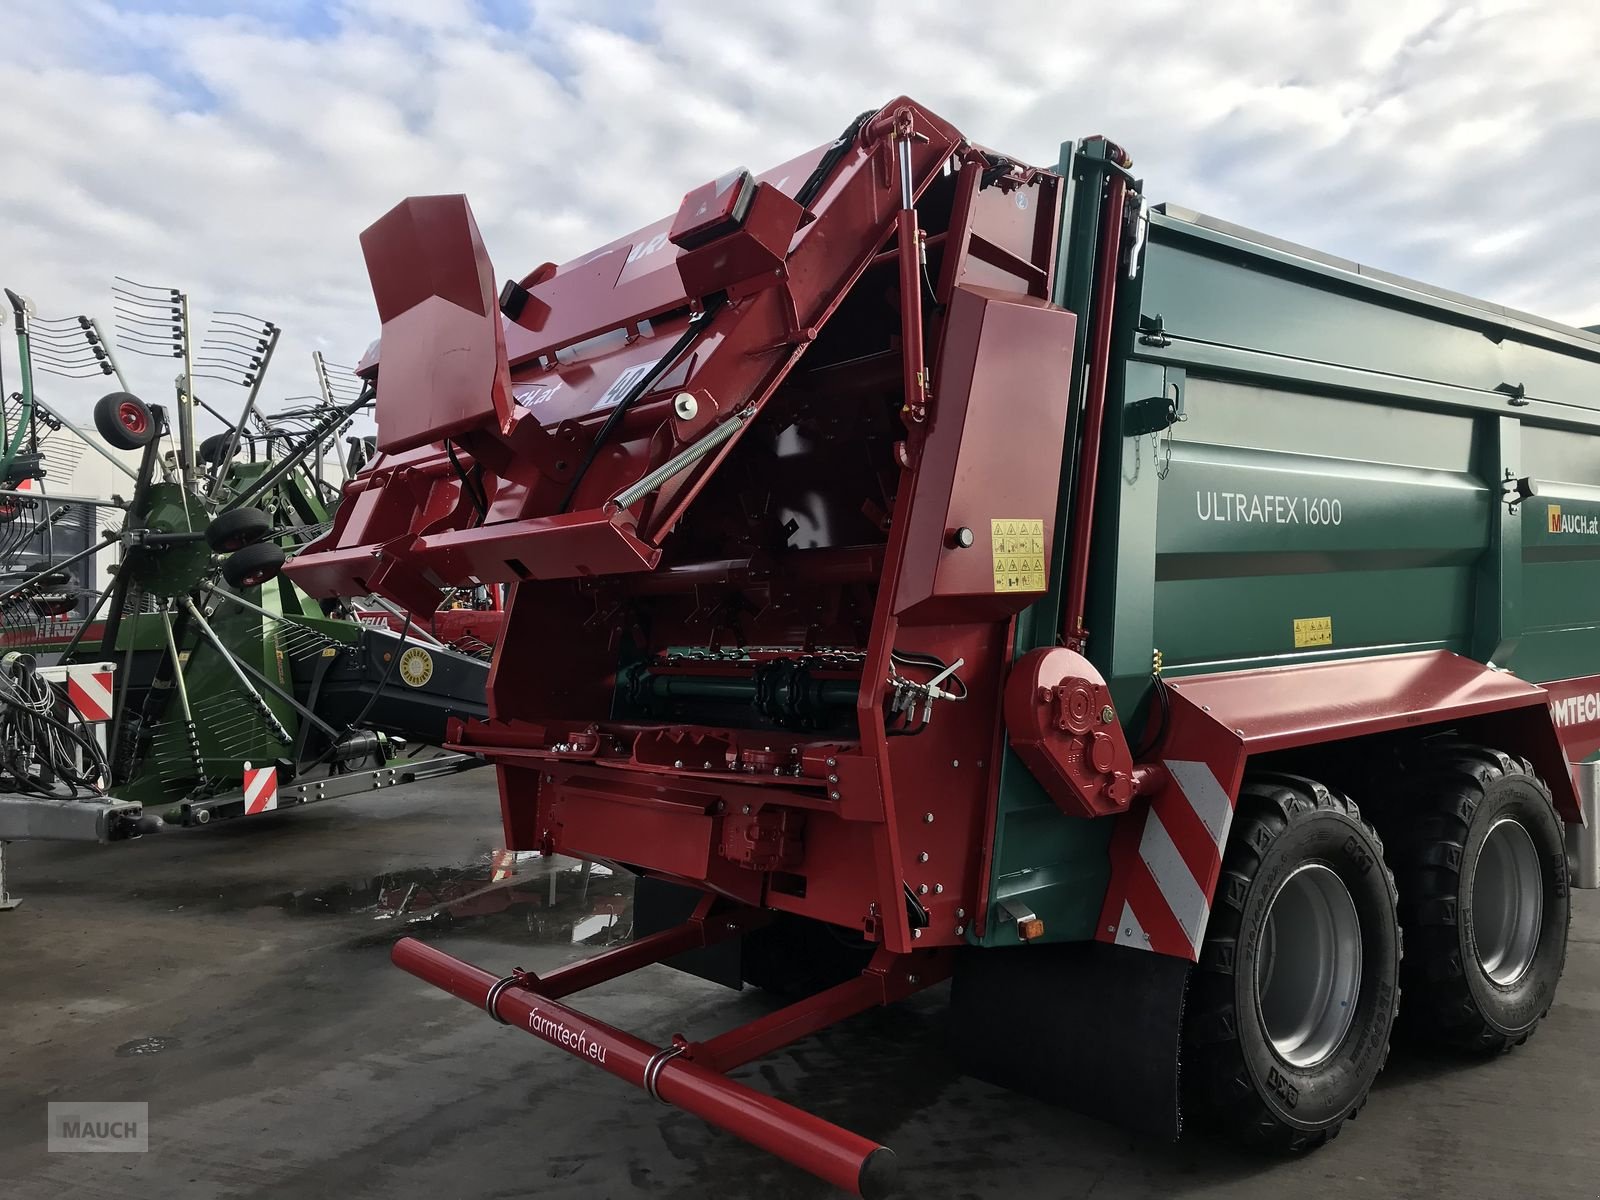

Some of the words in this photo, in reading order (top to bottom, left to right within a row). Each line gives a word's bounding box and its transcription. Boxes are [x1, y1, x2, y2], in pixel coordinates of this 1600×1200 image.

[1197, 491, 1299, 524] ULTRAFEX
[1302, 497, 1342, 525] 1600
[1552, 514, 1598, 535] MAUCH.at
[1343, 836, 1374, 876] BKT
[528, 1007, 607, 1064] farmtech.eu
[1267, 1066, 1299, 1109] BKT
